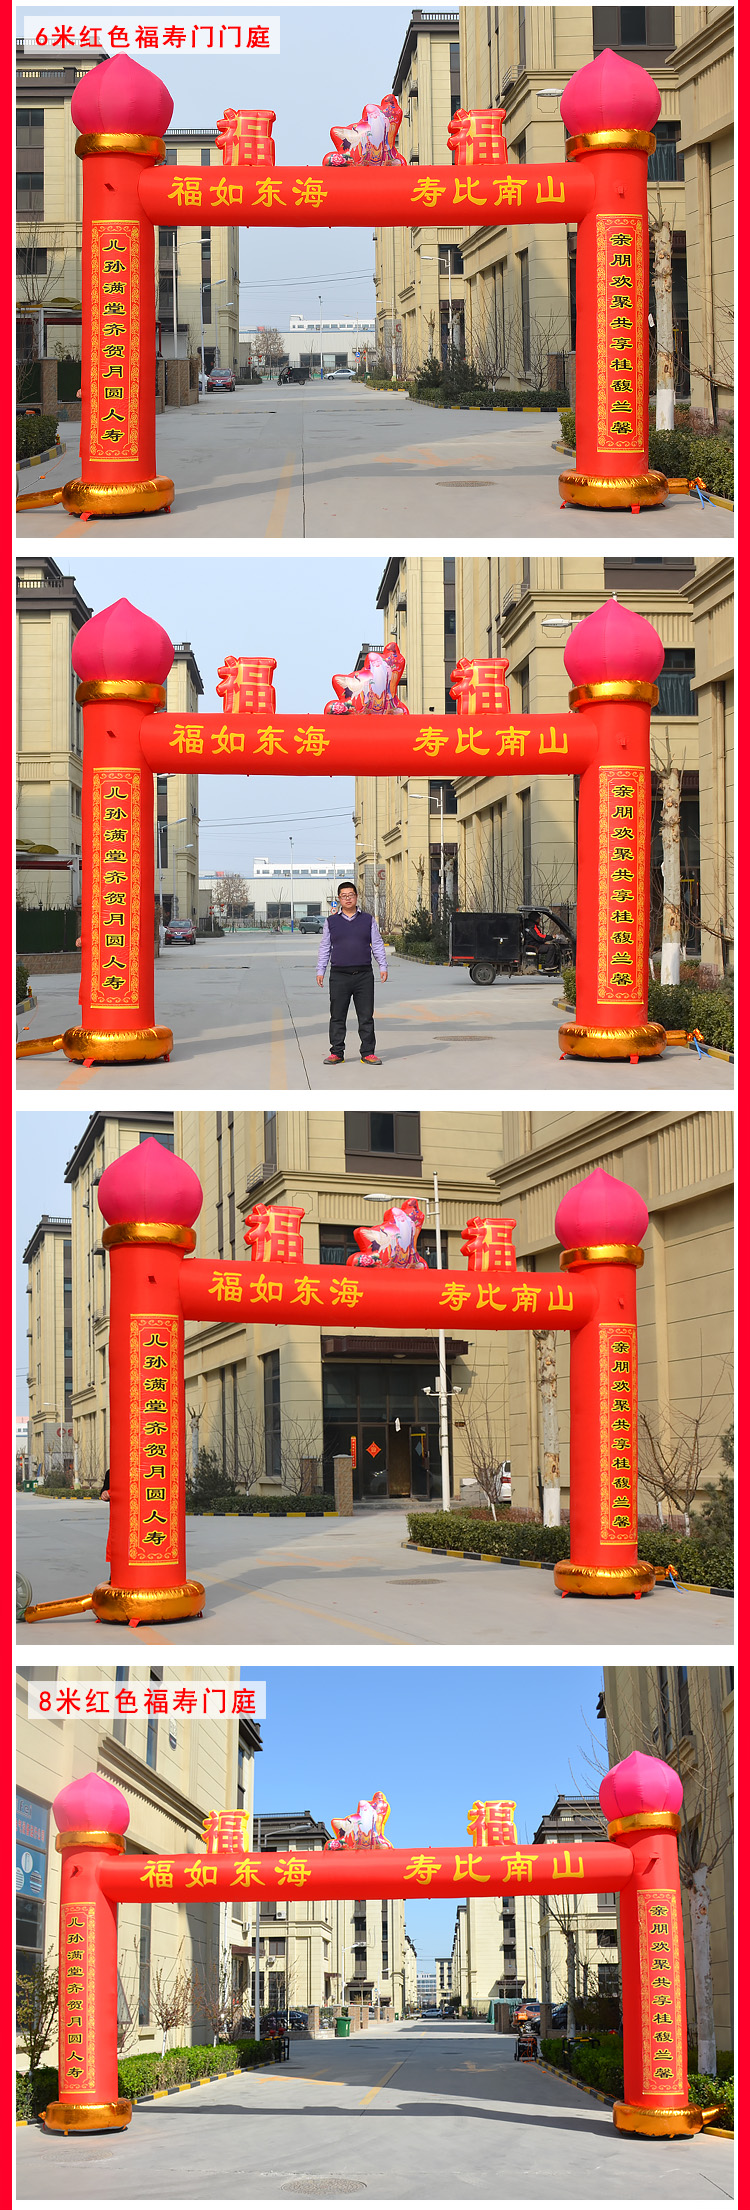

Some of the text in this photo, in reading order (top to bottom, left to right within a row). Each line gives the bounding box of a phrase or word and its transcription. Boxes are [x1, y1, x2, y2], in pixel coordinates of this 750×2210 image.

[215, 108, 276, 165] 福
[447, 108, 508, 165] 福
[167, 176, 328, 208] 福如东海
[410, 175, 567, 208] 寿比南山
[101, 239, 127, 443] 儿孙满堂齐贺月圆人寿
[608, 232, 634, 436] 亲朋欢聚共享桂馥兰馨
[216, 656, 276, 714] 福
[449, 657, 511, 714] 福
[169, 724, 330, 756] 福如东海
[413, 725, 569, 757] 寿比南山
[102, 786, 128, 991] 儿孙满堂齐贺月圆人寿
[610, 785, 635, 987] 亲朋欢聚共享桂馥兰馨
[244, 1203, 304, 1263] 福
[460, 1216, 517, 1272] 福
[208, 1270, 364, 1309] 福如东海
[439, 1281, 574, 1312] 寿比南山
[143, 1333, 168, 1547] 儿孙满堂齐贺月圆人寿
[610, 1340, 631, 1529] 亲朋欢聚共享桂馥兰馨
[202, 1809, 250, 1853] 福
[467, 1800, 517, 1847] 福
[140, 1856, 313, 1889] 福如东海
[404, 1849, 586, 1883] 寿比南山
[65, 1917, 86, 2081] 儿孙满堂齐贺月圆人寿
[648, 1904, 675, 2082] 亲朋欢聚共享桂馥兰馨
